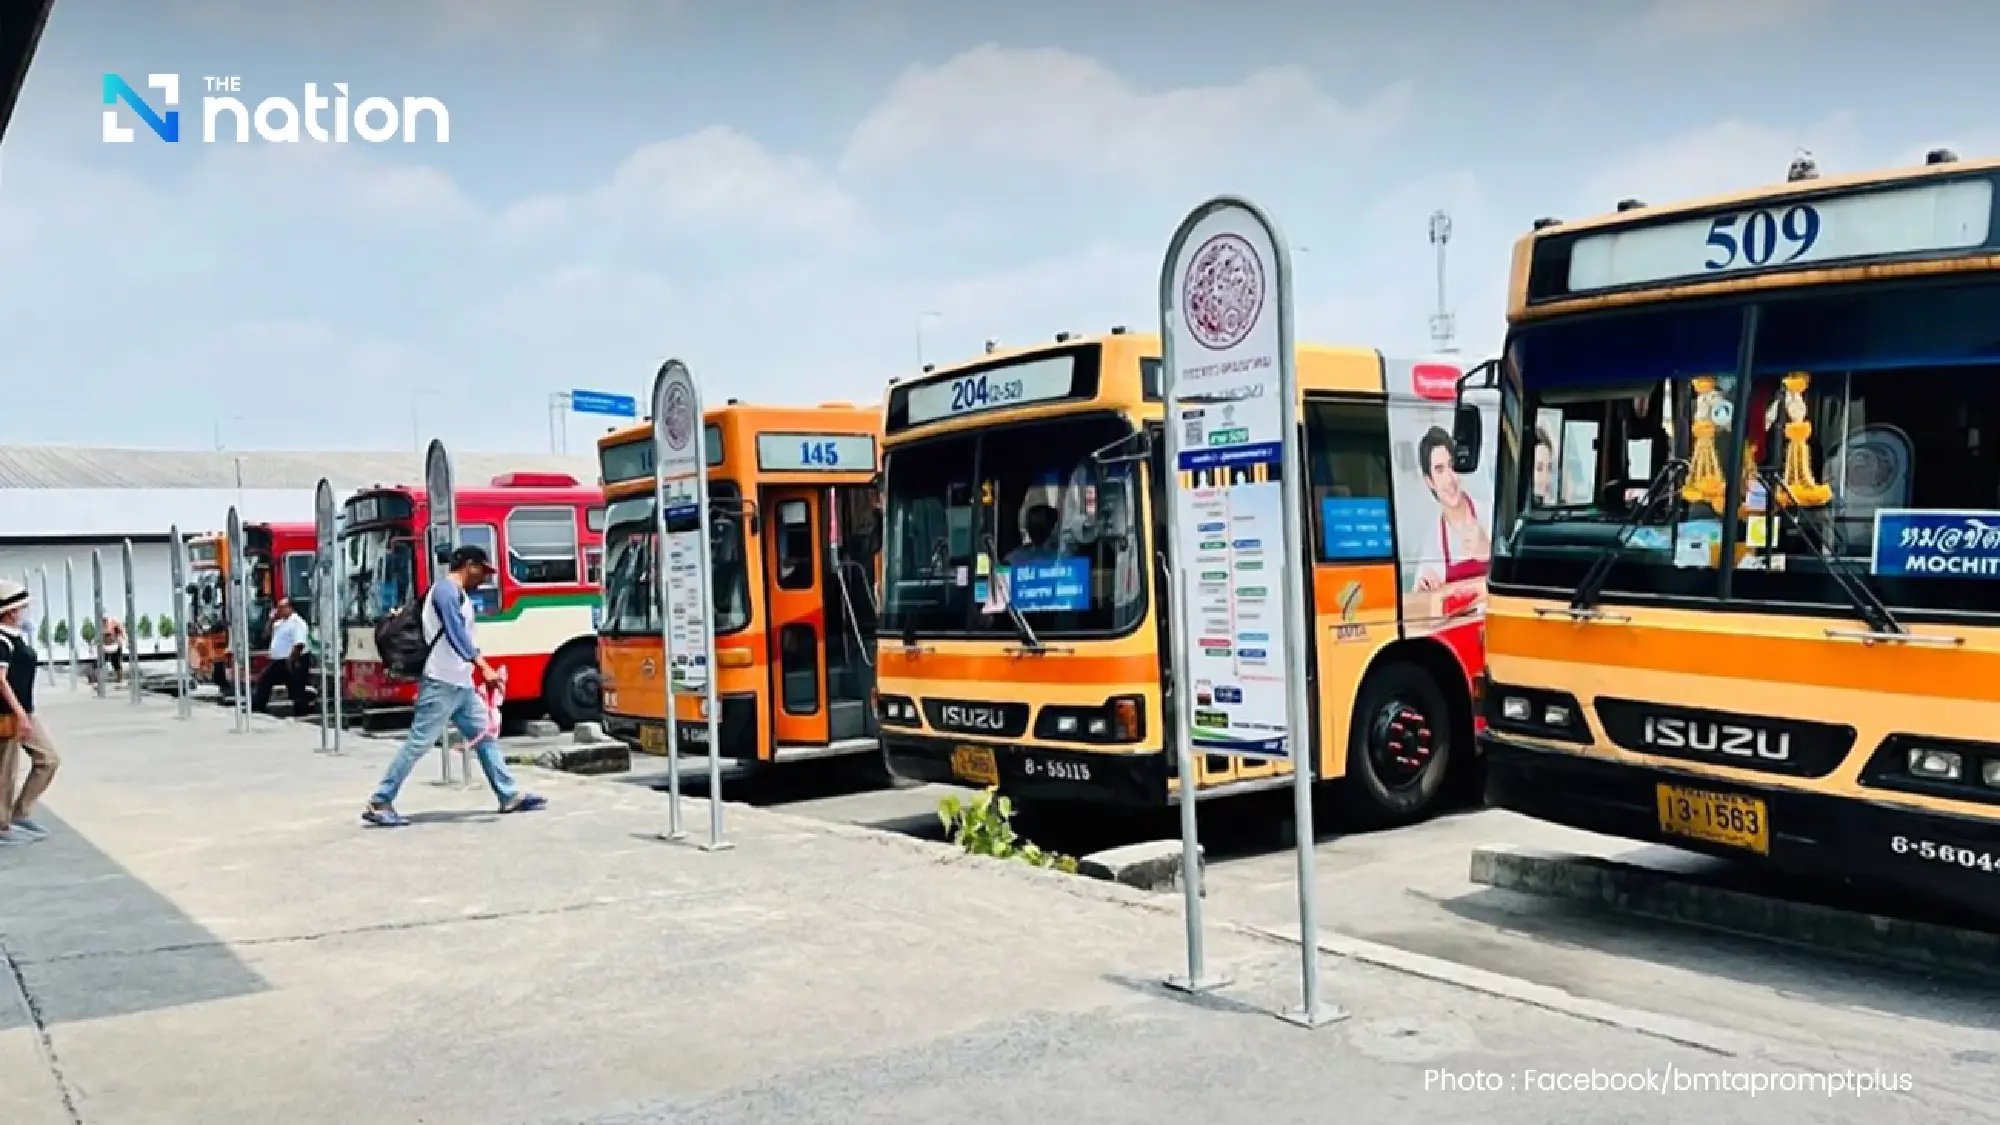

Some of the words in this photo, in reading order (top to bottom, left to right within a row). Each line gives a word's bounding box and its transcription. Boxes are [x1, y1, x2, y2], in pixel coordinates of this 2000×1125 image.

[1705, 204, 1820, 269] 509
[801, 441, 838, 466] 145
[1905, 554, 2000, 574] MOCHIT
[941, 705, 1004, 729] ISUZU
[1645, 716, 1790, 760] ISUZU
[1667, 796, 1760, 836] 13-1563
